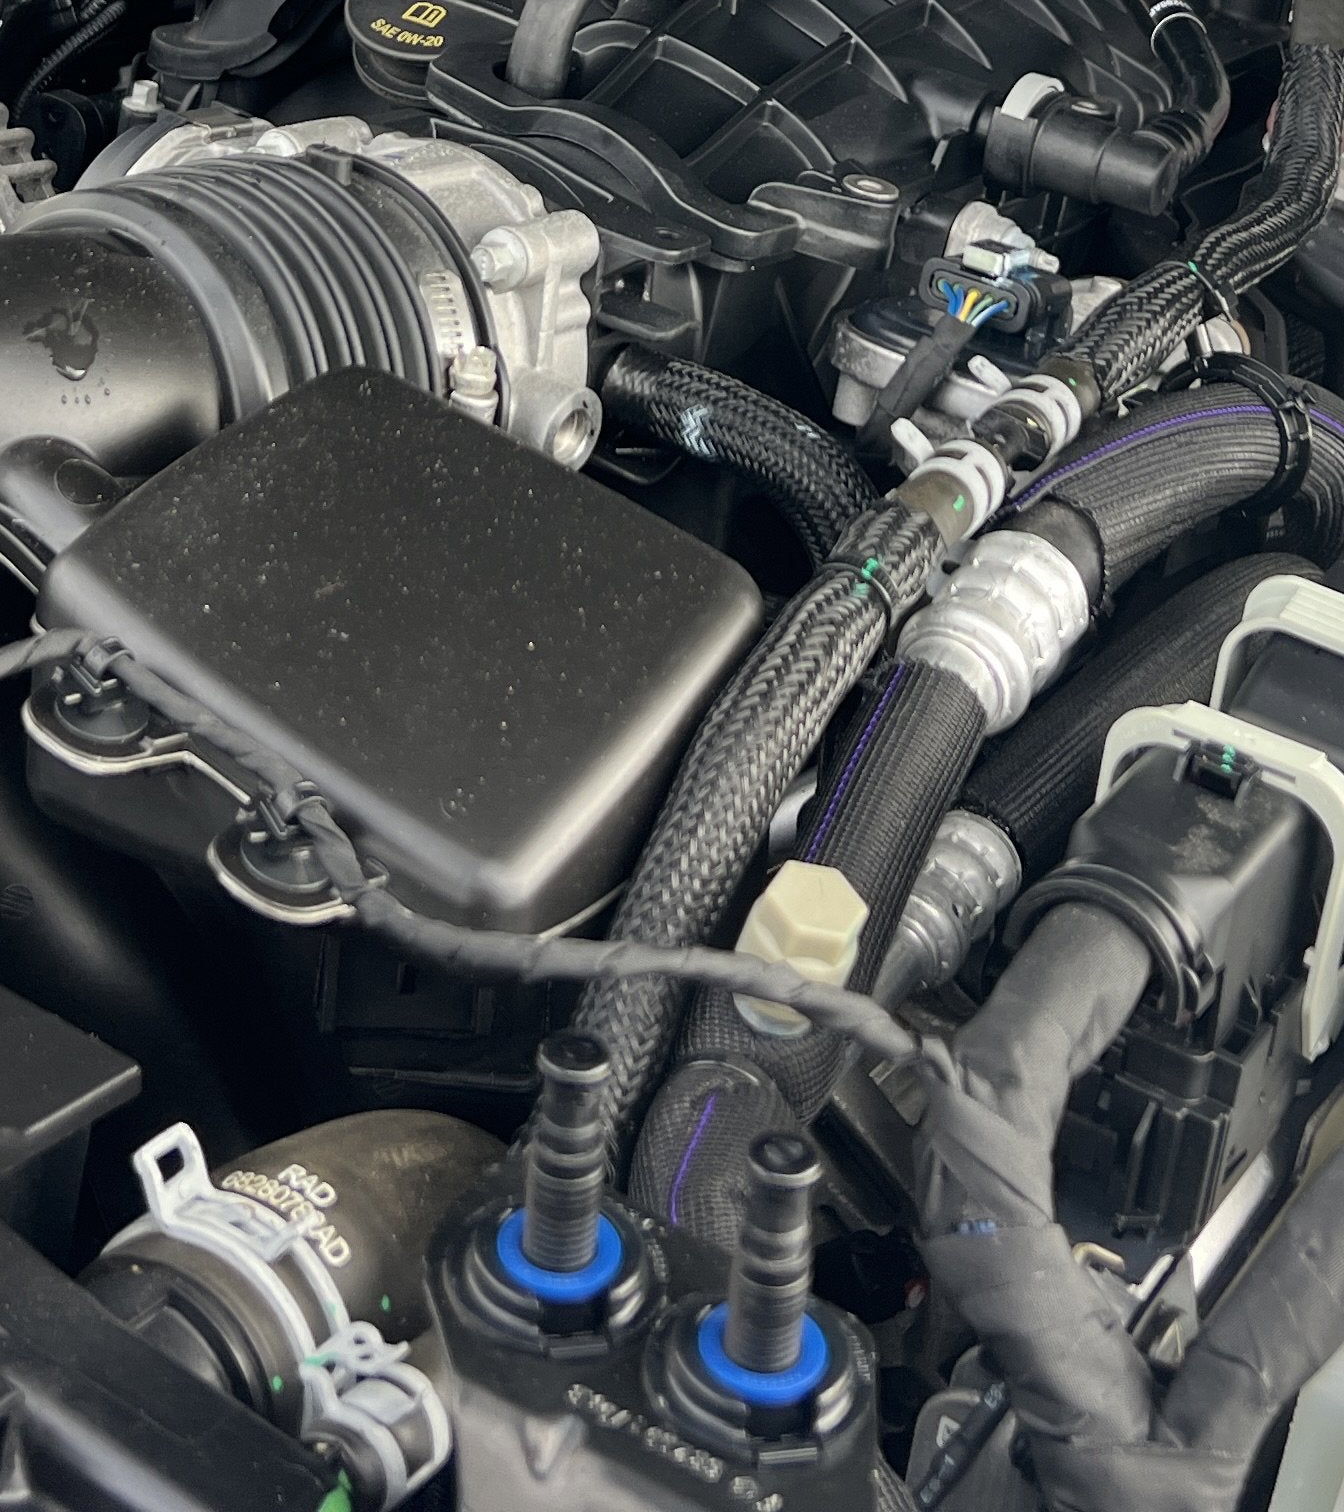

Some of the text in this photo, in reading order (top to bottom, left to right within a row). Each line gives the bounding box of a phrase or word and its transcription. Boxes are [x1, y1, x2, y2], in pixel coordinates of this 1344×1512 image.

[370, 18, 444, 48] SAE 0W-20
[278, 1163, 338, 1208] RAD
